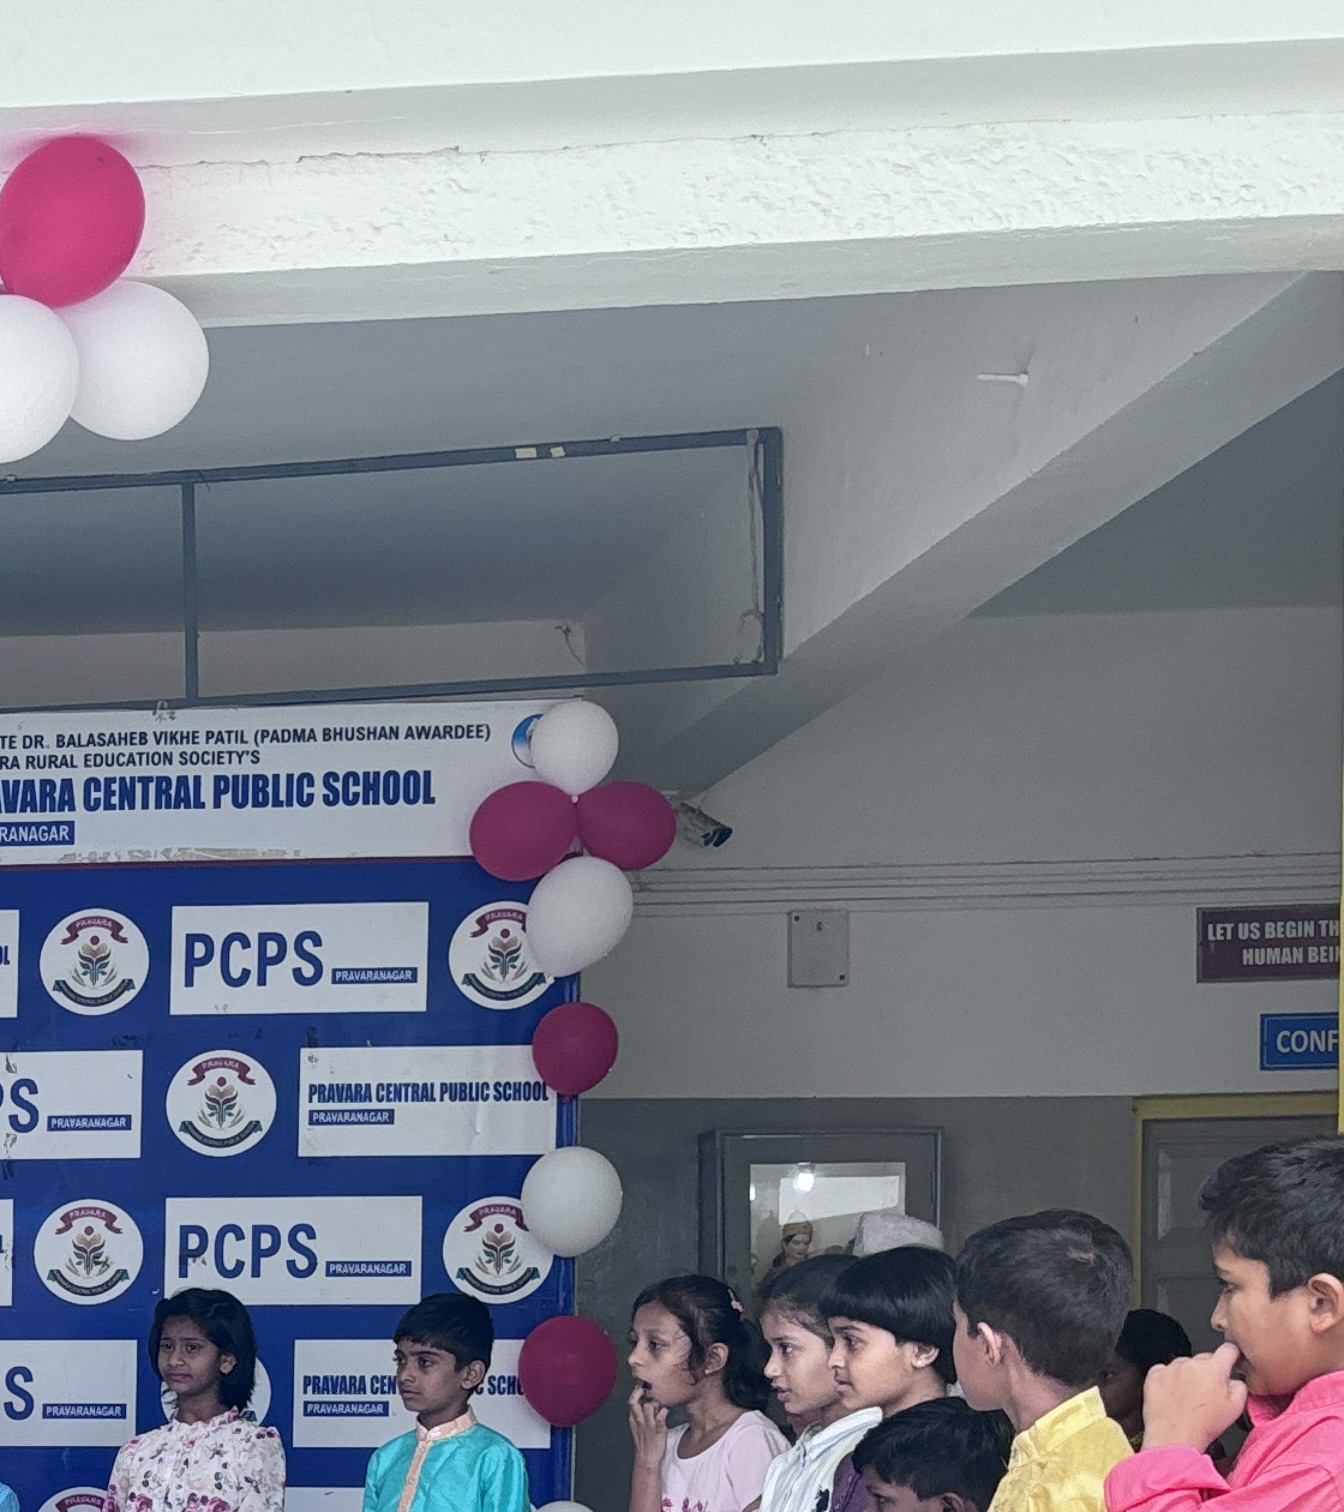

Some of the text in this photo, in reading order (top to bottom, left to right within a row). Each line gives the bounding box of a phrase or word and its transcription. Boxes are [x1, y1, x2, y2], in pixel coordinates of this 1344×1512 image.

[56, 731, 148, 748] BALASAHEB
[153, 730, 201, 746] VIKHE
[205, 729, 248, 745] PATIL
[254, 728, 317, 746] (PADMA
[323, 726, 399, 742] BHUSHAN
[404, 724, 491, 742] AWARDEE)
[26, 754, 78, 770] RURAL
[84, 751, 173, 768] EDUCATION
[179, 750, 260, 766] SOCIETY'S
[83, 774, 205, 812] CENTRAL
[213, 771, 314, 809] PUBLIC
[322, 769, 436, 807] SCHOOL
[1207, 923, 1234, 941] LET
[1238, 922, 1261, 940] US
[1264, 920, 1315, 939] BEGIN
[184, 930, 324, 988] PCPS
[1242, 947, 1304, 966] HUMAN
[335, 970, 412, 982] PRAVARANAGAR
[308, 1080, 549, 1104] PRAVARA CENTRAL PUBLIC SCHOOL
[51, 1117, 127, 1129] PRAVARANAGAR
[313, 1112, 390, 1123] PRAVARANAGAR
[179, 1223, 318, 1279] PCPS
[330, 1263, 407, 1275] PRAVARANAGAR
[303, 1375, 367, 1396] PRAVARA
[46, 1405, 122, 1417] PRAVARANAGAR
[307, 1403, 384, 1415] PRAVARANAGAR
